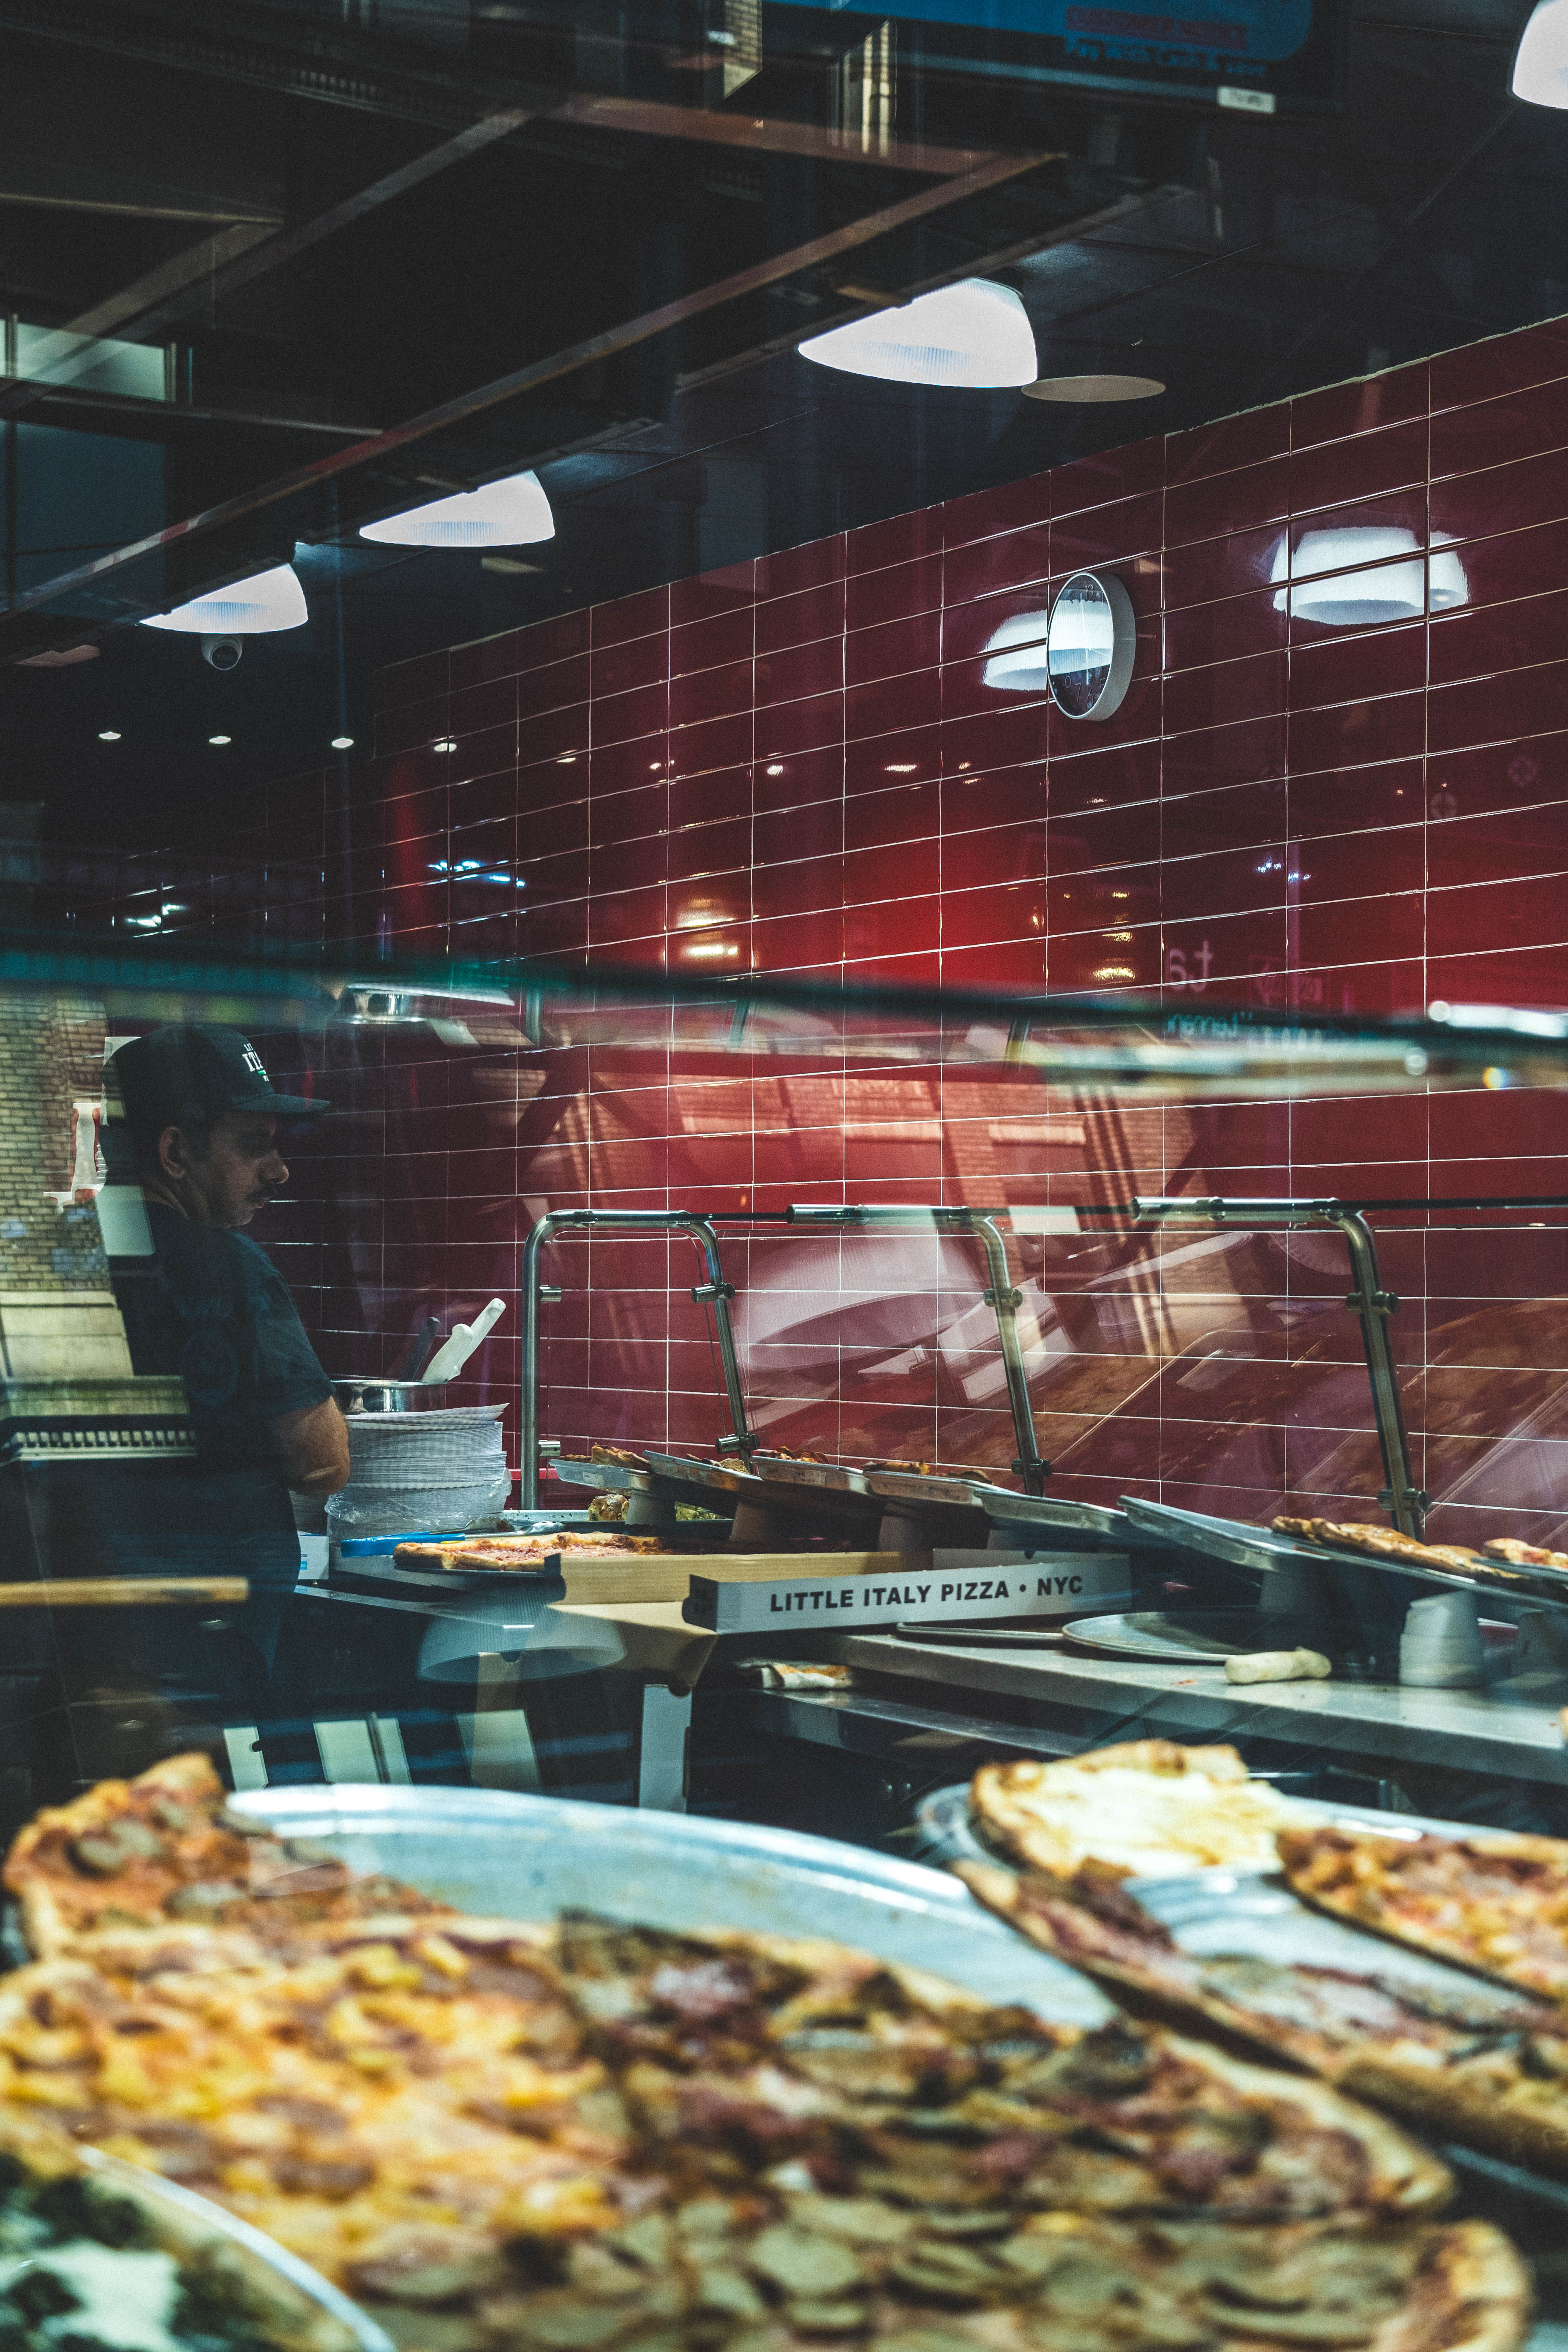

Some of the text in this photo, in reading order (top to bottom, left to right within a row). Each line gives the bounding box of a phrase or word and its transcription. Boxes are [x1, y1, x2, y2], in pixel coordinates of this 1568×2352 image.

[1085, 585, 1094, 603] 12
[1074, 683, 1081, 703] 7
[1086, 688, 1093, 708] 6
[770, 1589, 853, 1612] LITTLE
[864, 1585, 931, 1606] ITALY
[941, 1581, 1009, 1601] PIZZA
[1037, 1576, 1082, 1595] NYC
